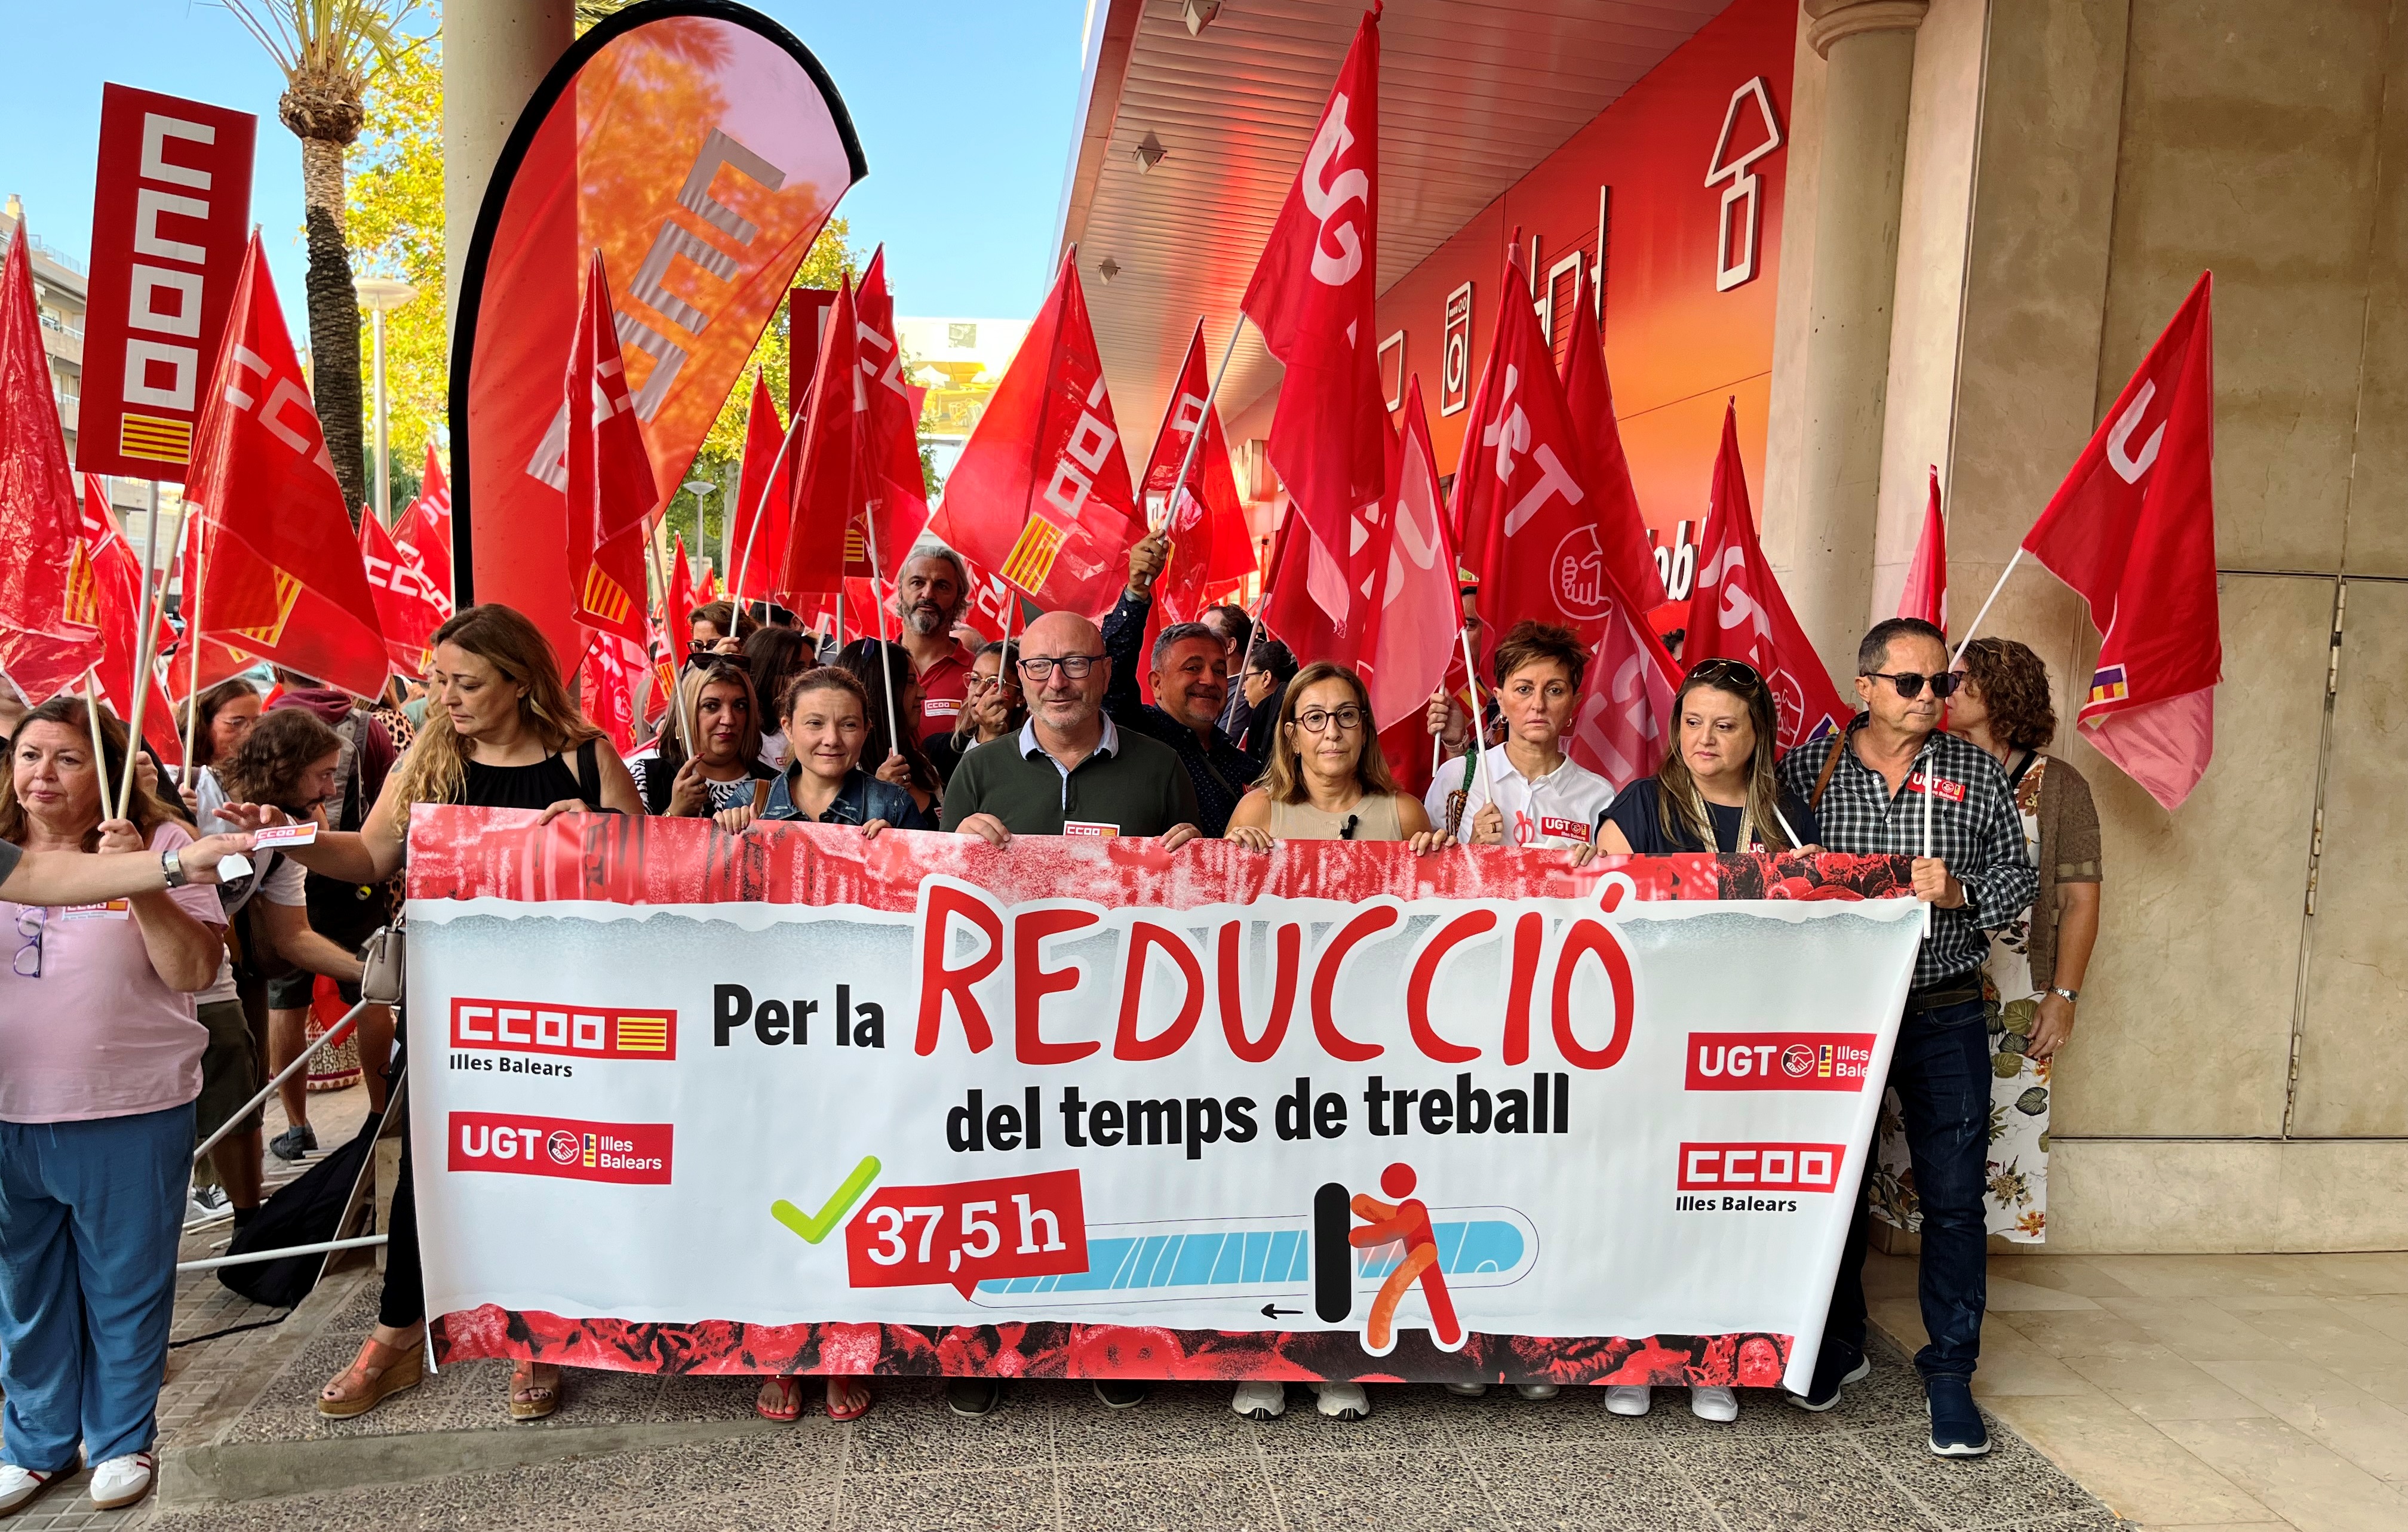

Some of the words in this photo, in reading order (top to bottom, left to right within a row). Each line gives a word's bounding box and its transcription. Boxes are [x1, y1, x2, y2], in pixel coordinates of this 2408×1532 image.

[1067, 826, 1100, 835] CCOO
[1546, 819, 1571, 830] UGT
[714, 983, 818, 1047] Per
[836, 983, 884, 1048] la
[914, 882, 1634, 1070] REDUCCIÓ
[459, 1005, 606, 1050] CCOO
[450, 1055, 493, 1070] Illes
[499, 1057, 573, 1077] Balears
[1699, 1045, 1777, 1076] UGT
[1837, 1047, 1869, 1060] Illes
[947, 1086, 1040, 1152] del
[1059, 1085, 1258, 1160] temps
[1274, 1077, 1347, 1140] de
[1363, 1072, 1569, 1136] treball
[462, 1125, 542, 1160] UGT
[601, 1136, 634, 1152] Illes
[600, 1154, 662, 1170] Balears
[1686, 1150, 1832, 1184] CCOO
[1676, 1196, 1716, 1211] Illes
[1722, 1196, 1797, 1212] Balears
[867, 1200, 1001, 1273] 37,5
[1012, 1193, 1066, 1254] h
